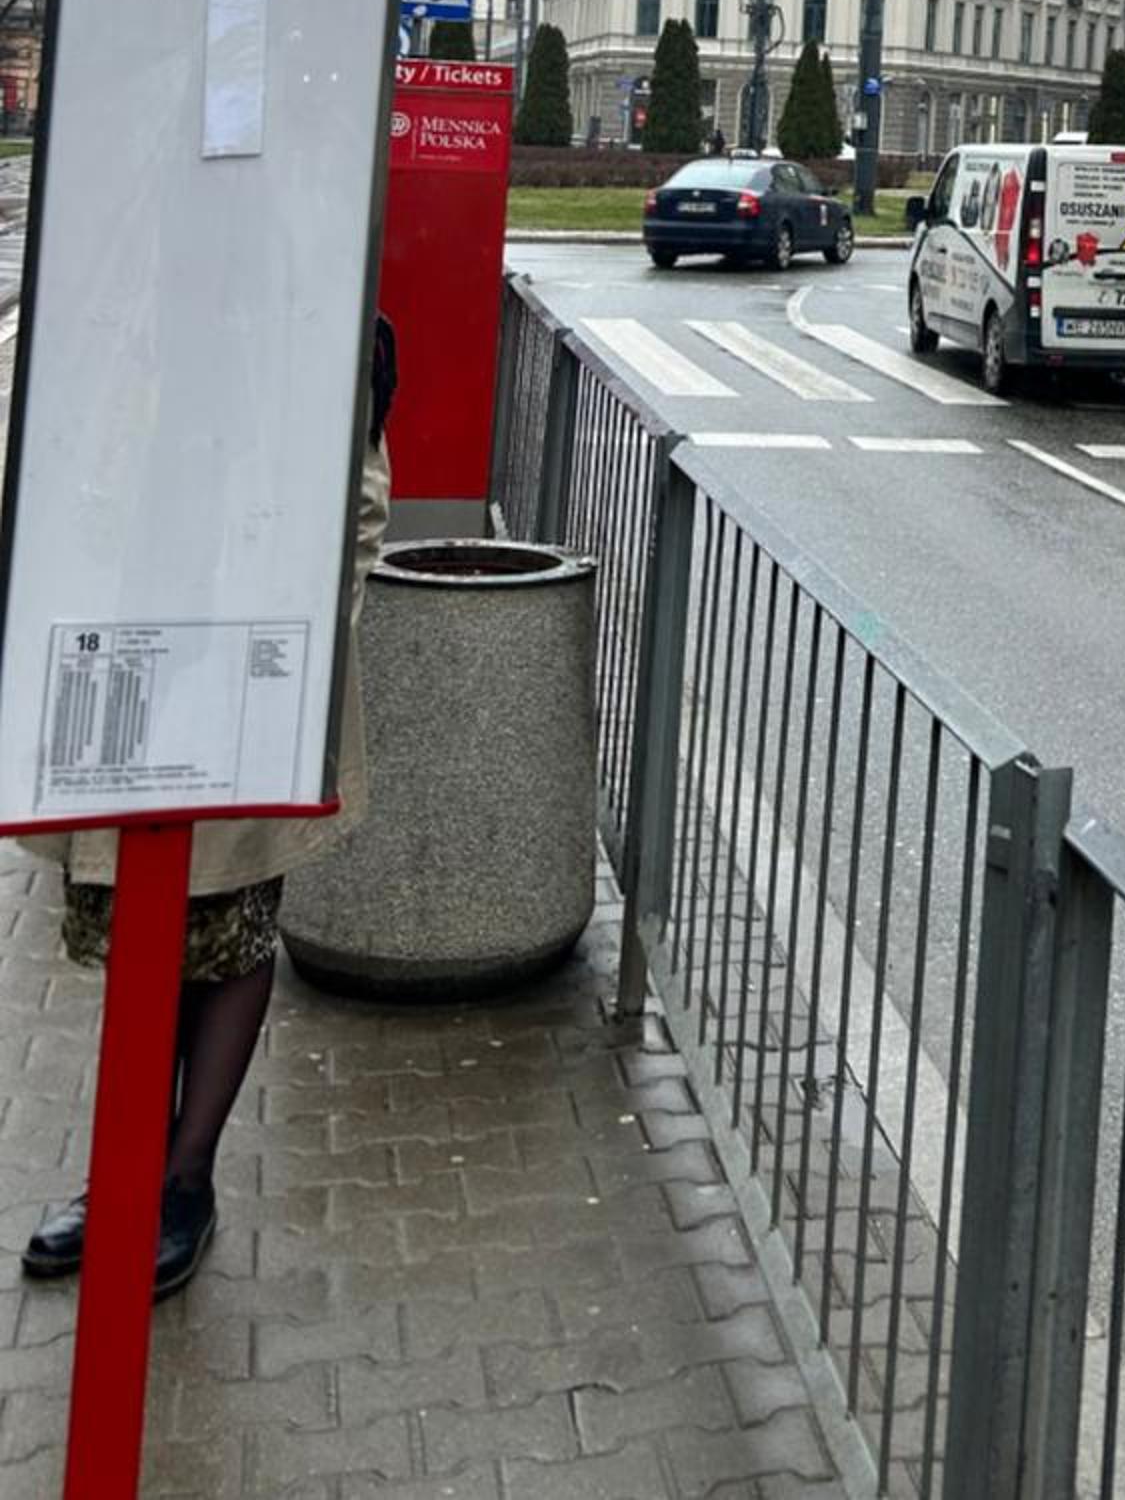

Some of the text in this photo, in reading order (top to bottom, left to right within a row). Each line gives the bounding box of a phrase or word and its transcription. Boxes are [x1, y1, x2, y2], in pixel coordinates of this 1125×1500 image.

[431, 64, 502, 86] Tickets
[421, 116, 502, 135] MENNICA
[420, 132, 487, 149] POLSKA
[76, 632, 100, 652] 18
